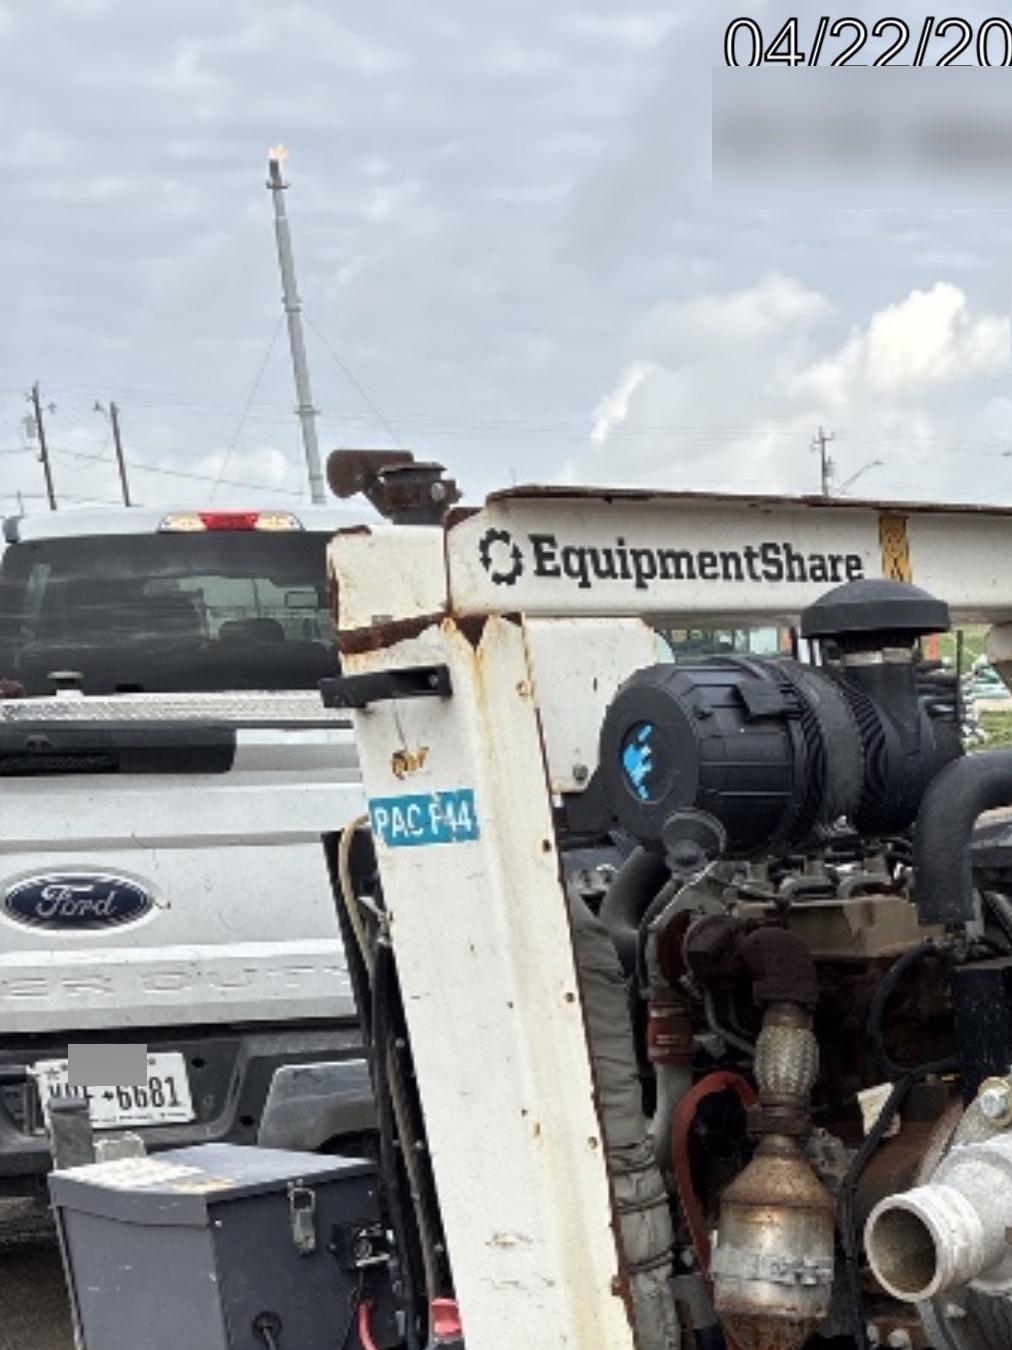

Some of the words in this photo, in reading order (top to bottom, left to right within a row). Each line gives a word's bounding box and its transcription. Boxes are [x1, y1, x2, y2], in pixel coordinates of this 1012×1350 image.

[528, 533, 865, 590] EquipmentShare
[374, 803, 424, 839] PAC
[35, 884, 118, 917] Ford
